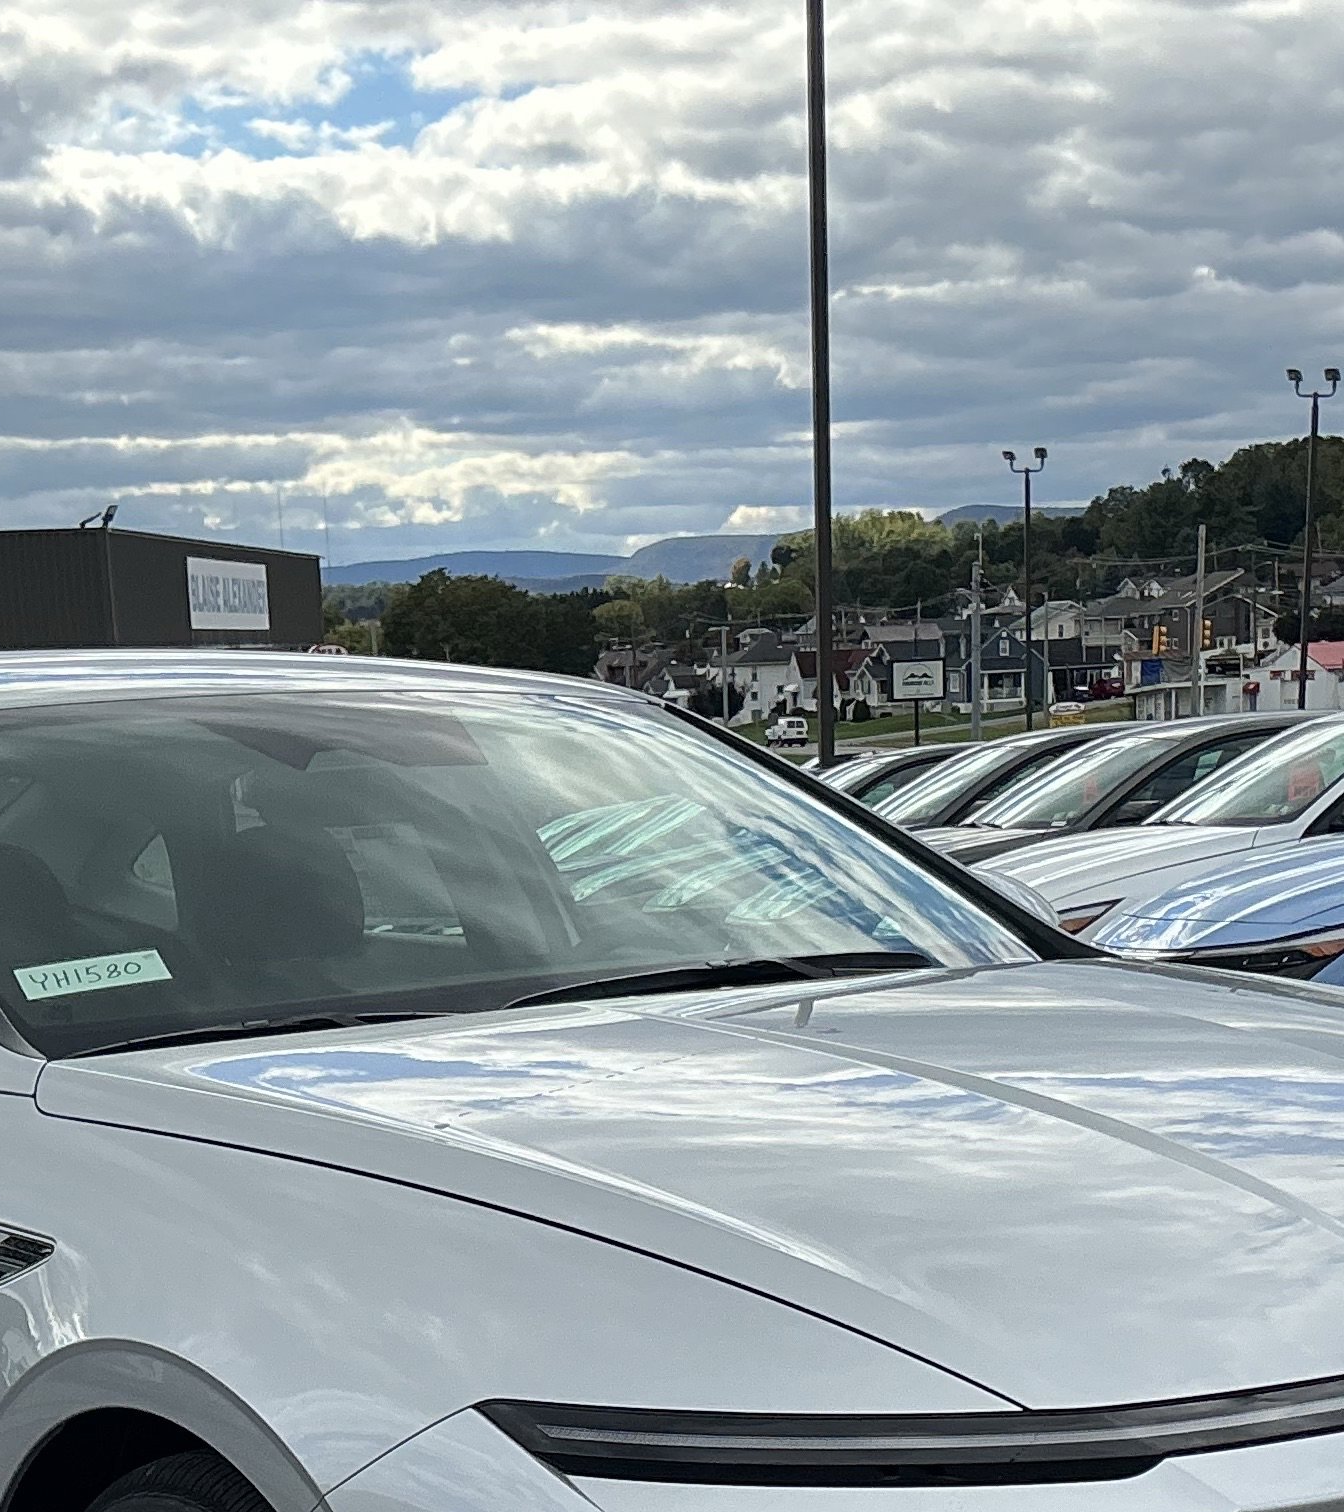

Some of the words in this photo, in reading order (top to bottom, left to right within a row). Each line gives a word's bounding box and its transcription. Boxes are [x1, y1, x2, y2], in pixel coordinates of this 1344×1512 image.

[190, 574, 221, 613] BLAISE
[221, 577, 266, 615] ALEXANDER
[28, 961, 142, 991] YH1580
